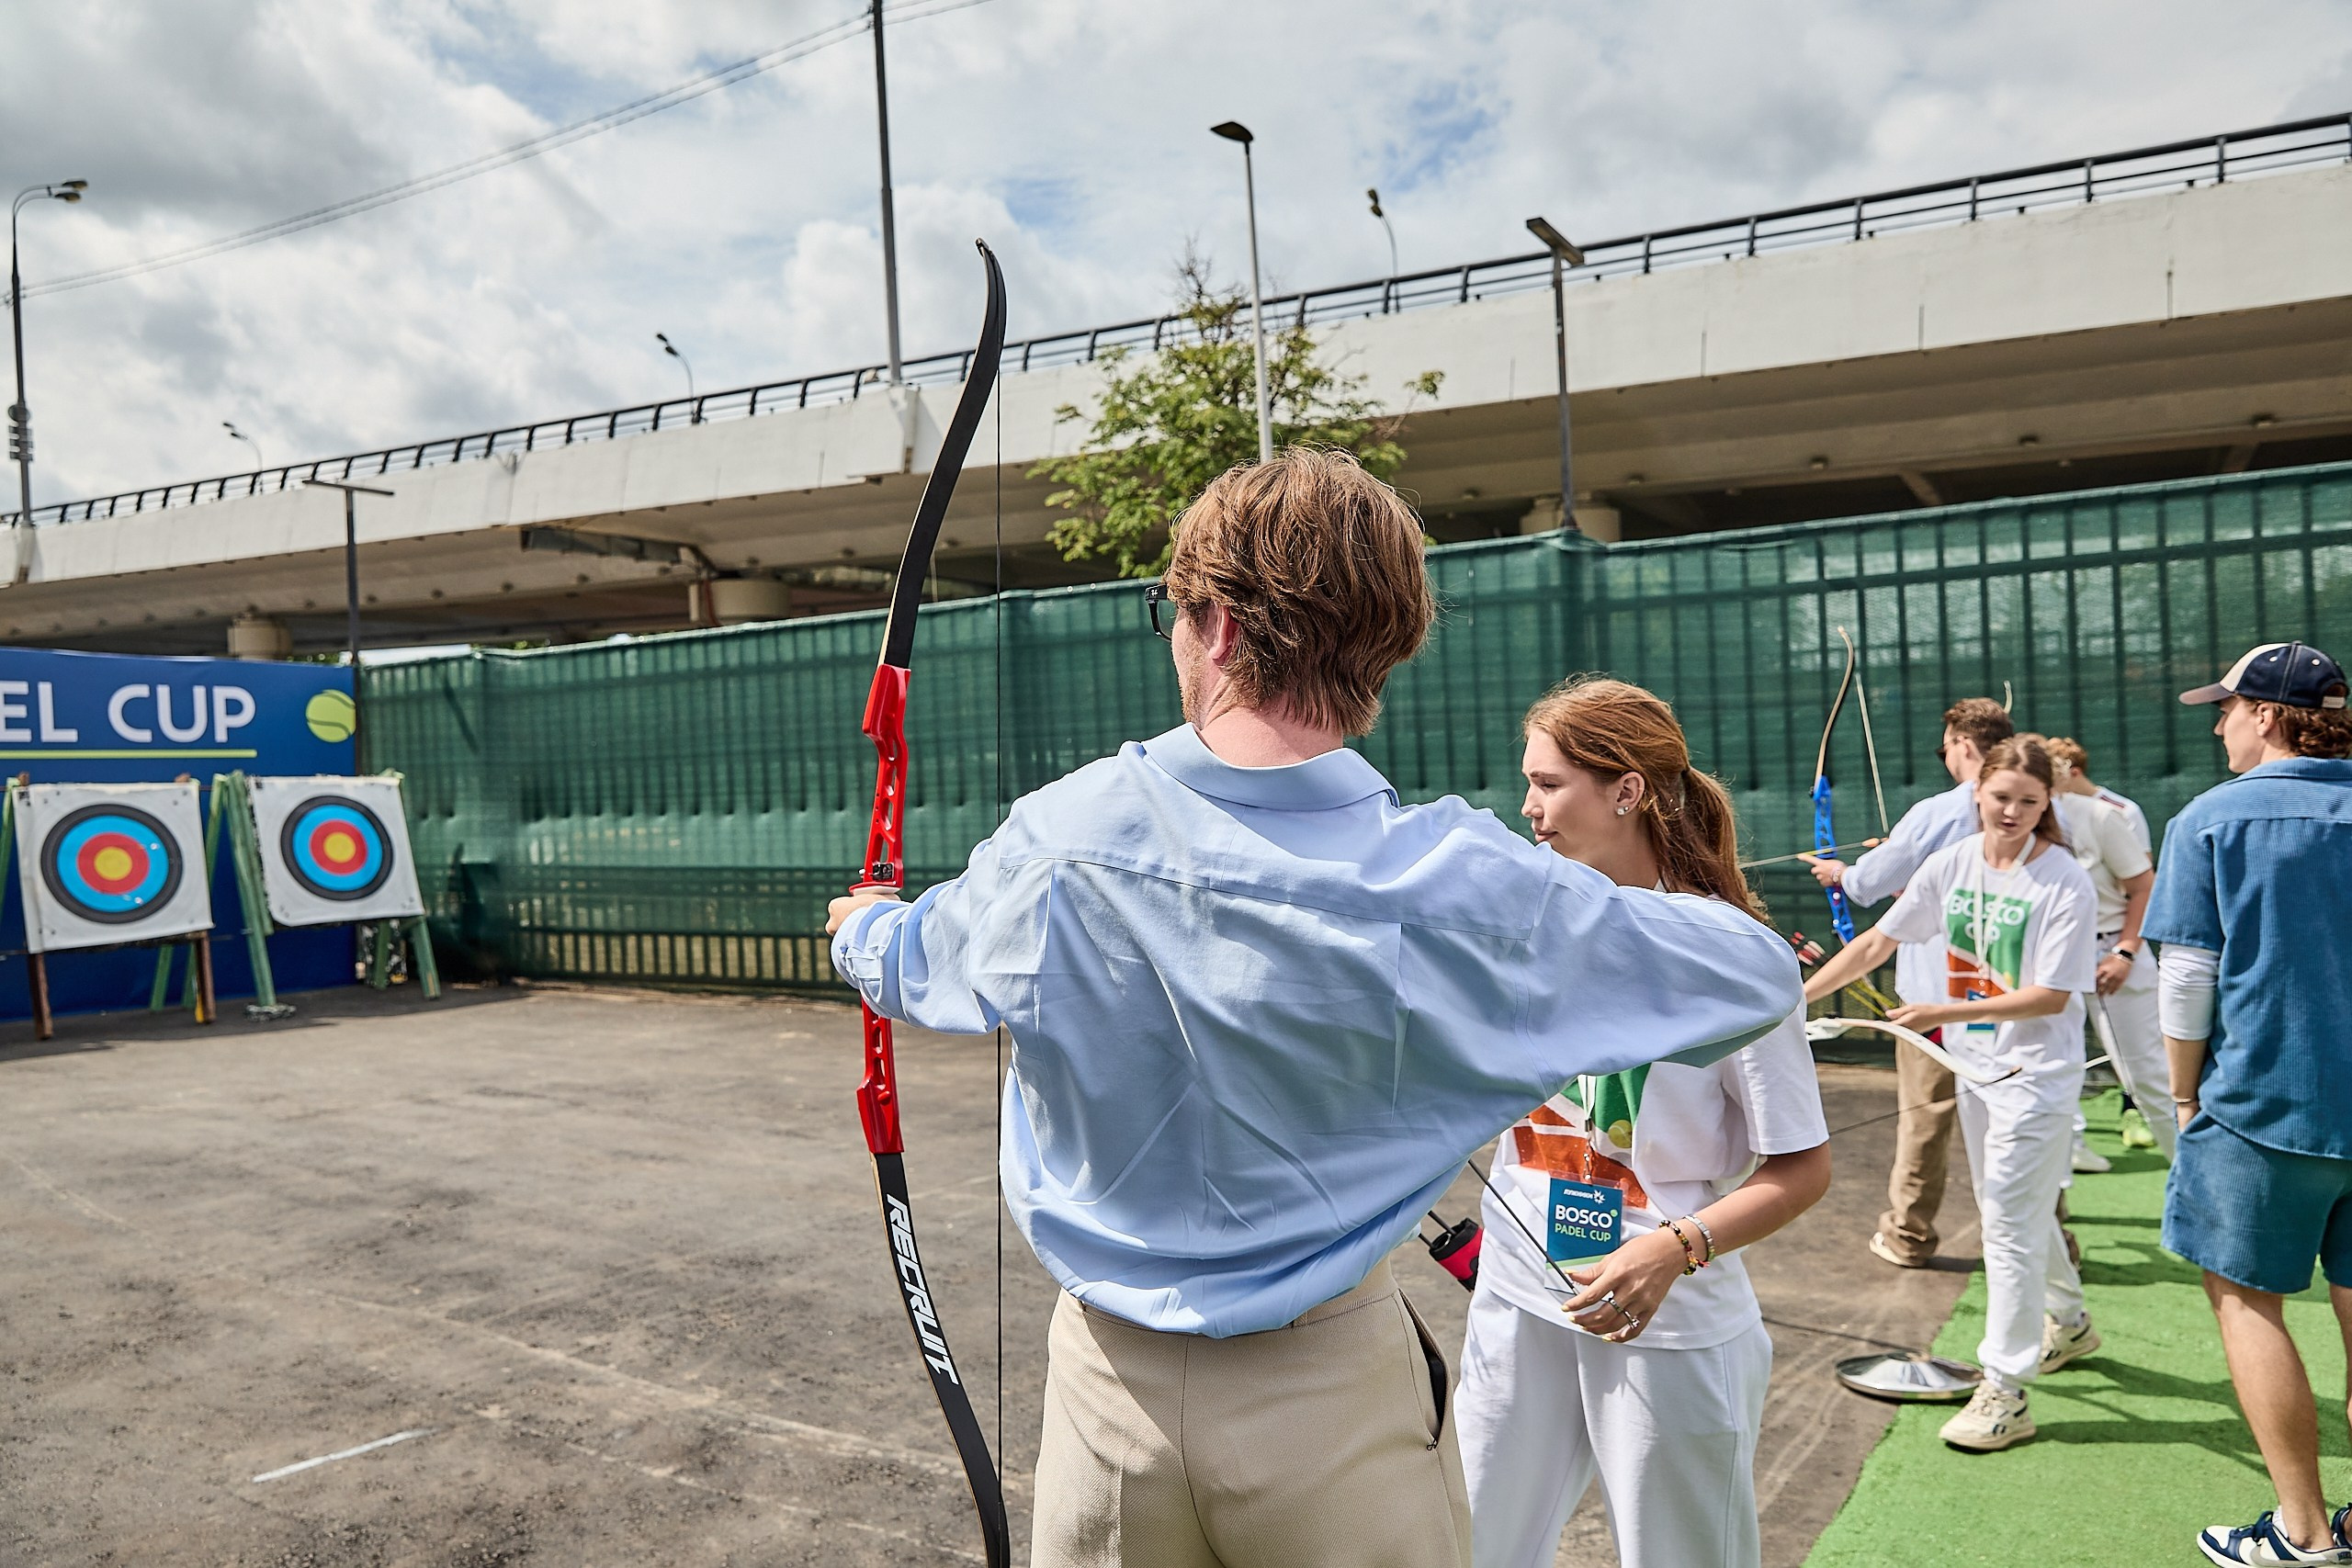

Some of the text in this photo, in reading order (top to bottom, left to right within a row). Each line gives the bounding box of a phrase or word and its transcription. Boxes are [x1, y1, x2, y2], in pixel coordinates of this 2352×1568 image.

[0, 680, 256, 743] EL CUP
[1555, 1204, 1612, 1228] BOSCO
[1555, 1223, 1611, 1242] PADEL CUP
[886, 1194, 959, 1384] RECRUIT
